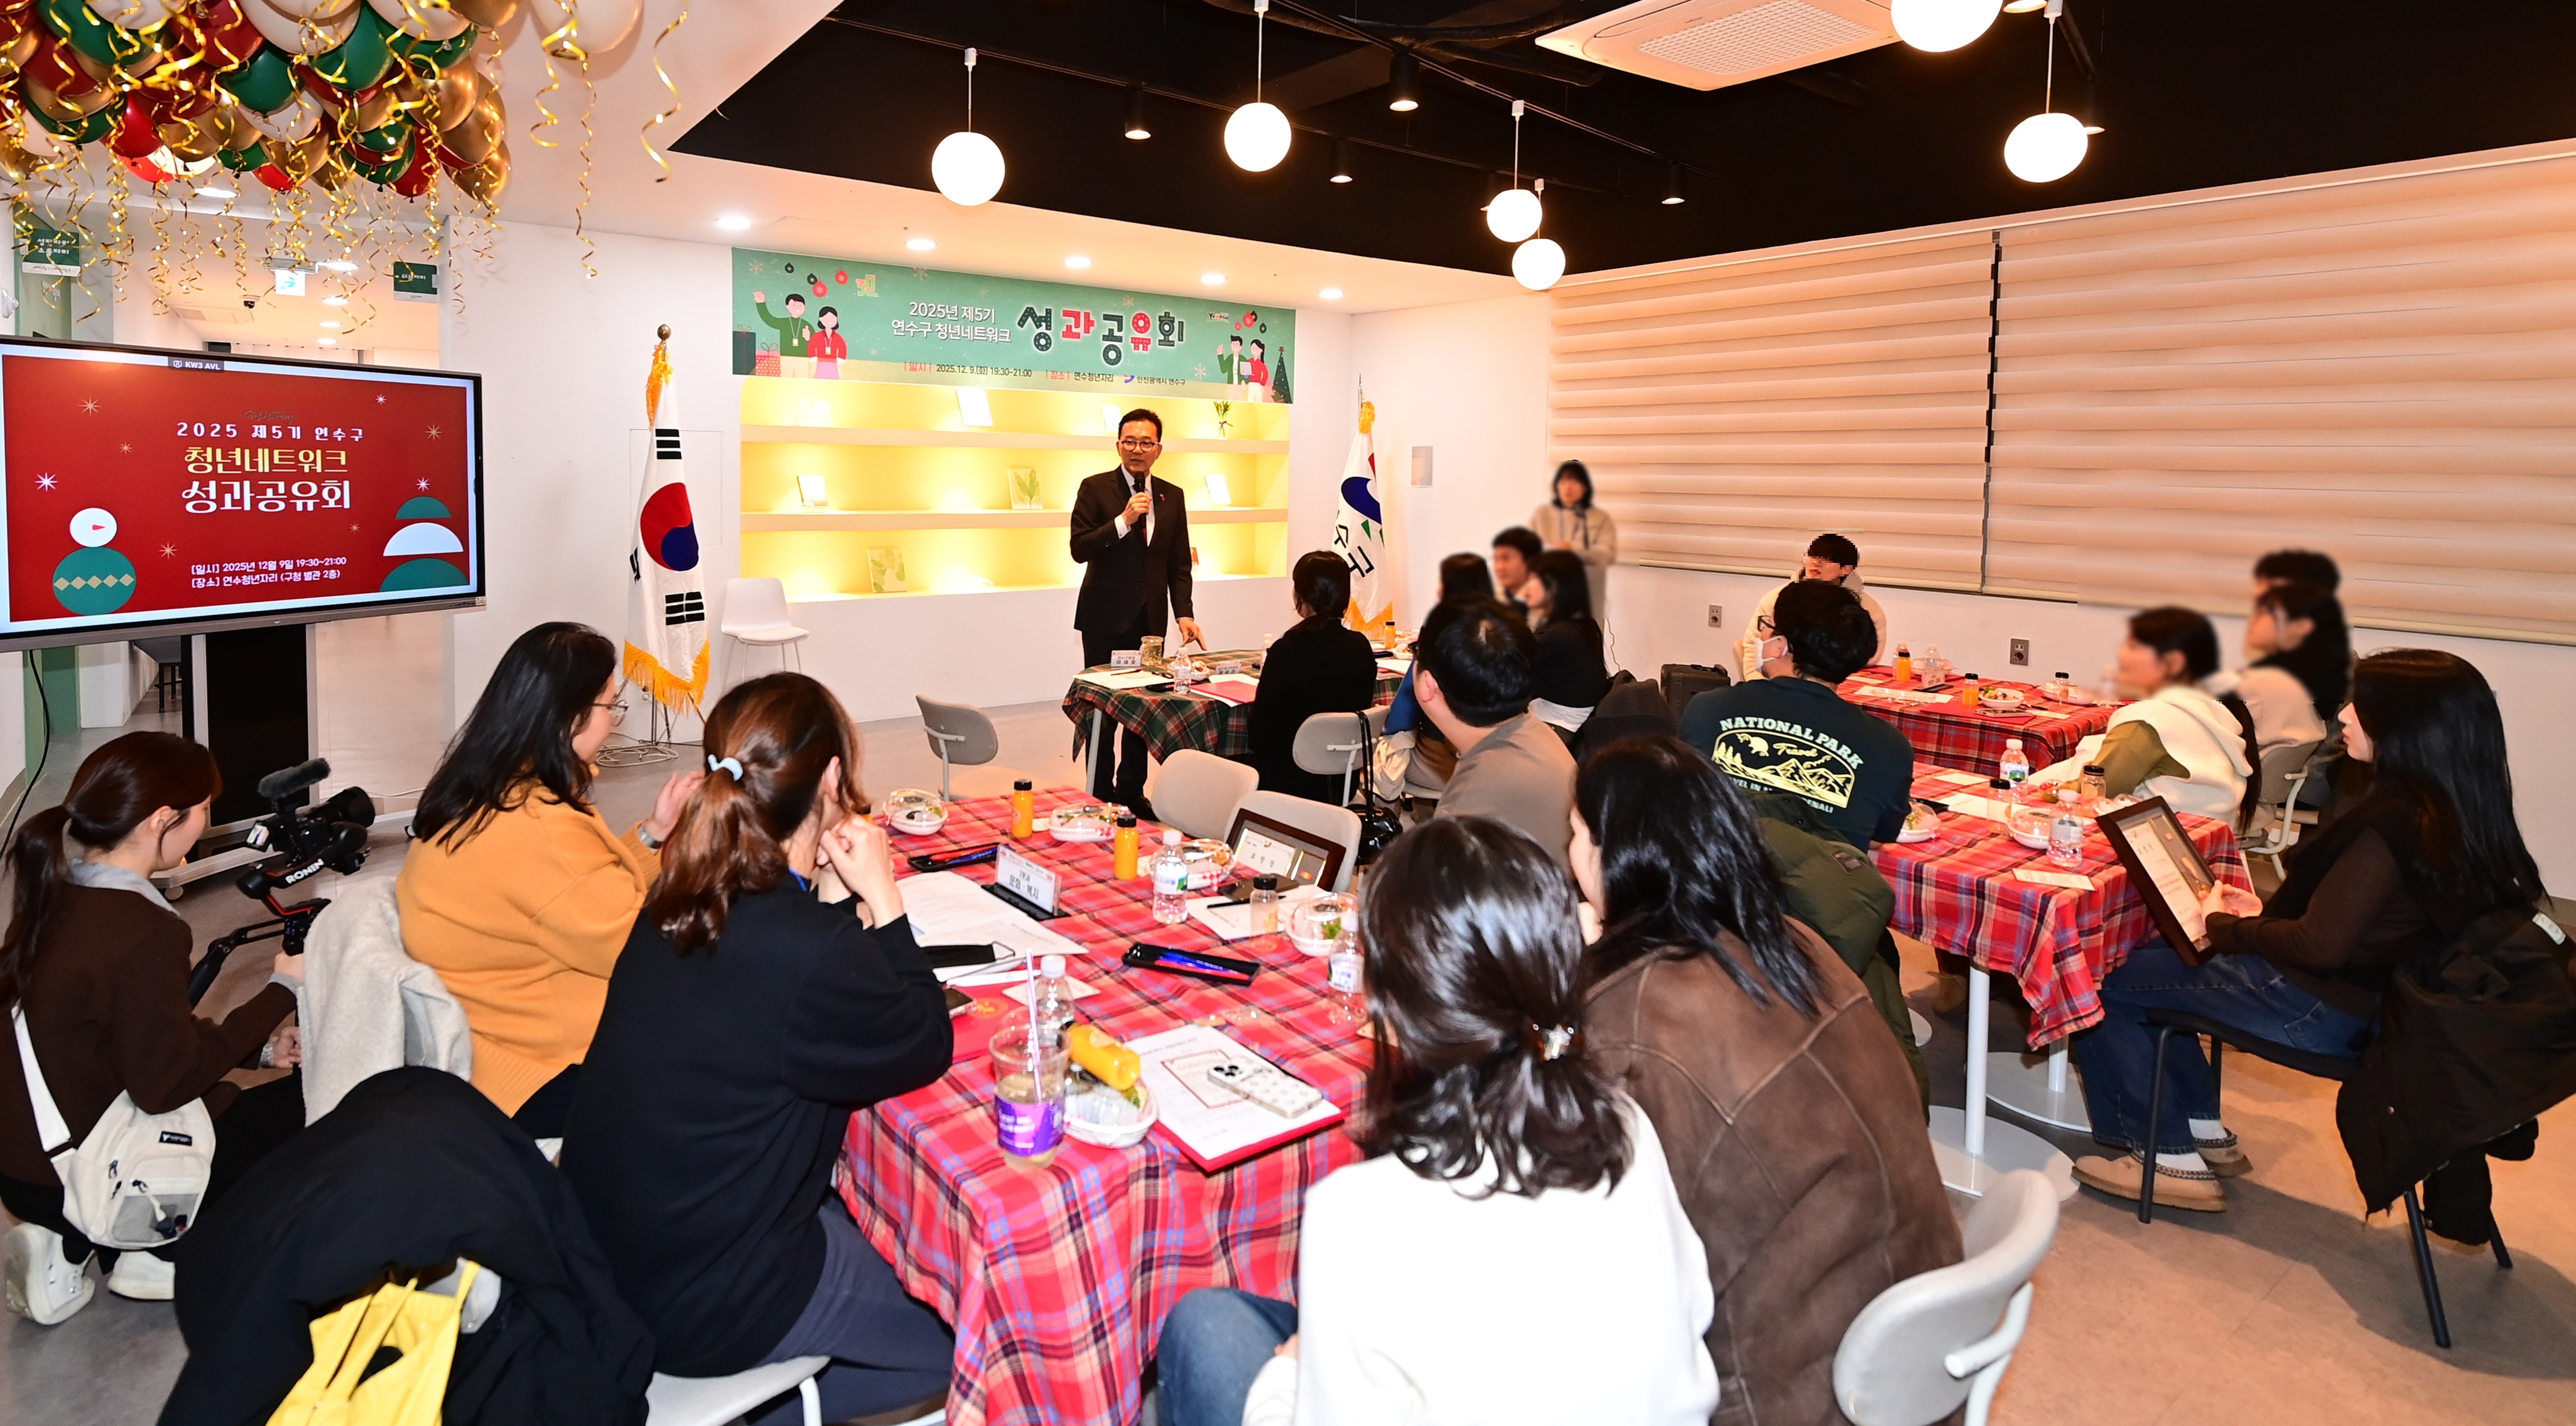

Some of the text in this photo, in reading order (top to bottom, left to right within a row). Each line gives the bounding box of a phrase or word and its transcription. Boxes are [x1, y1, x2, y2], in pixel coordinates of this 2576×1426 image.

[909, 301, 996, 324] 2025년 제5기
[891, 319, 1012, 343] 연수구 청년네트워크
[1017, 306, 1184, 366] 성과공유회
[990, 367, 1032, 377] 19:30-21:00
[1074, 371, 1114, 382] 연수청년자리
[1137, 376, 1166, 385] 인천광역시
[176, 422, 363, 441] 2025 제5기 연수구
[184, 447, 348, 474] 청년네트워크
[181, 480, 350, 514] 성과공유회
[191, 557, 347, 575] [일시] 2025년 12월 9일 19:30~21:00
[192, 569, 341, 588] [장소] 연수청년자리 (구청 별관 2층)
[1719, 717, 1864, 769] NATIONAL PARK
[1773, 743, 1818, 757] Travel
[285, 858, 324, 884] RONIN
